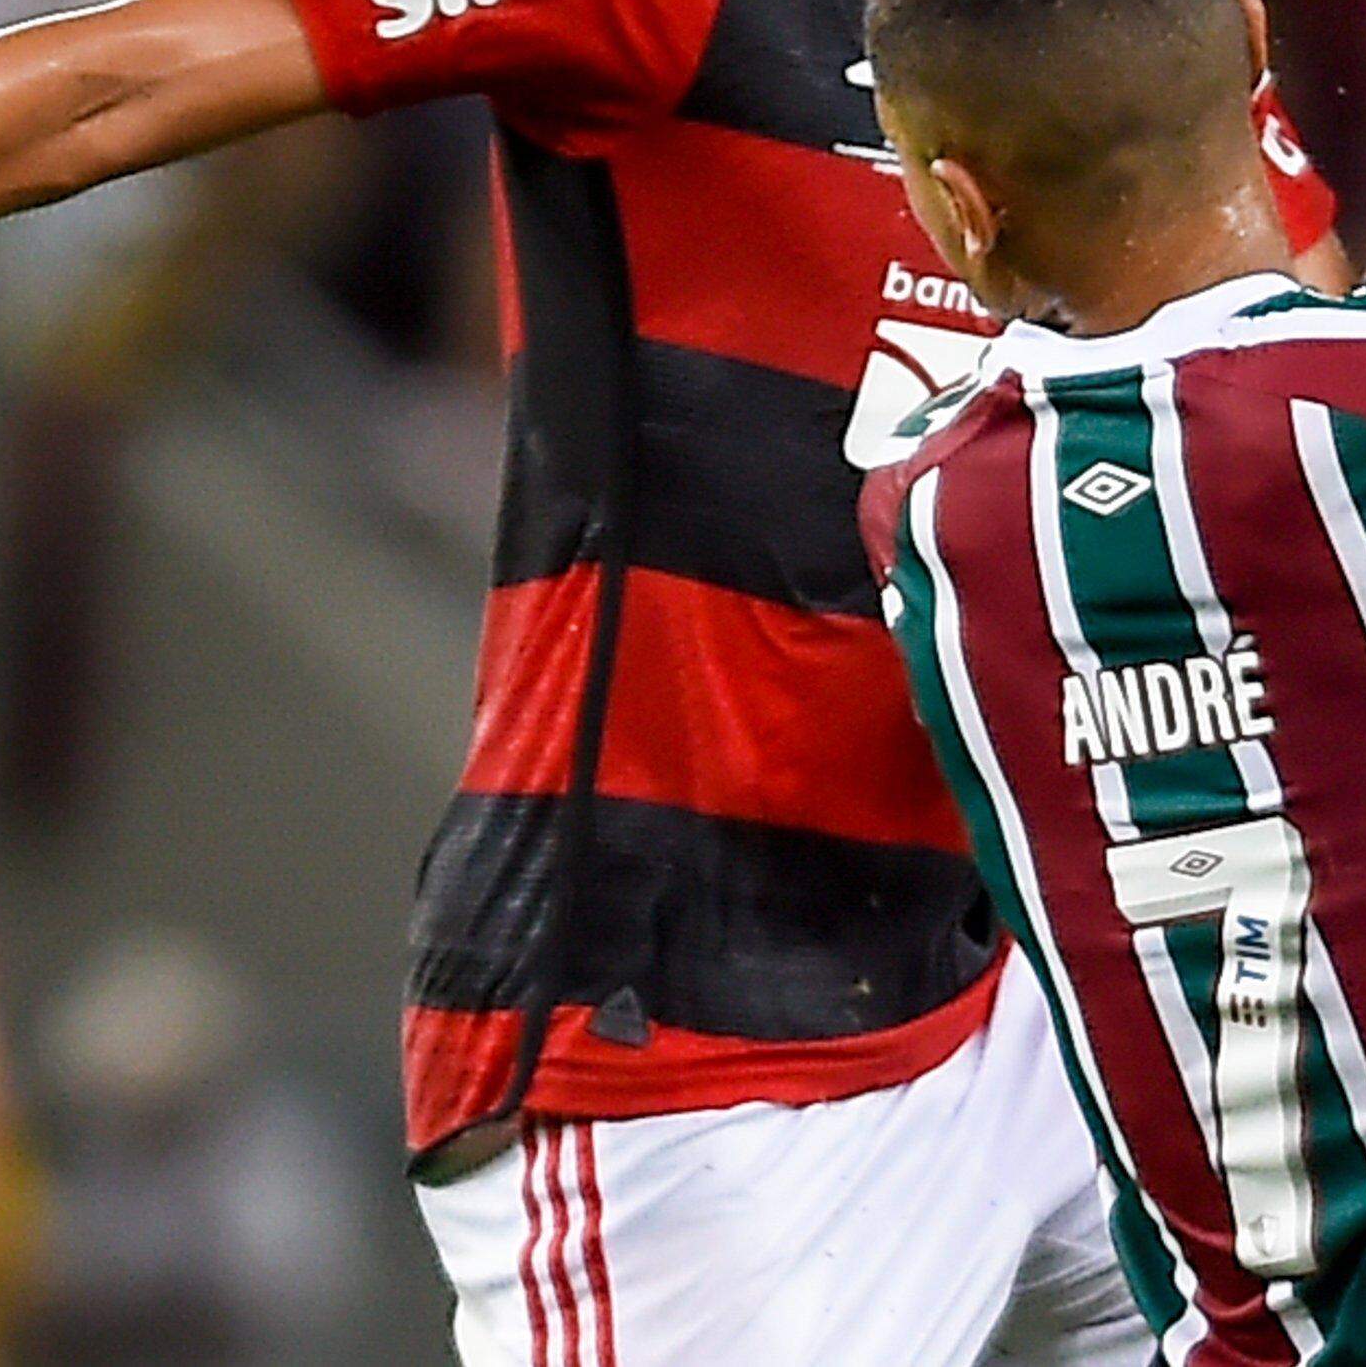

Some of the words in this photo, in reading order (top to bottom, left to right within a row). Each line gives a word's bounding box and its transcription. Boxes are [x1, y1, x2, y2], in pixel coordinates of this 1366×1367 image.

[1062, 634, 1276, 766] ANDRÉ
[1235, 915, 1271, 984] TIM
[1105, 814, 1314, 1276] 7
